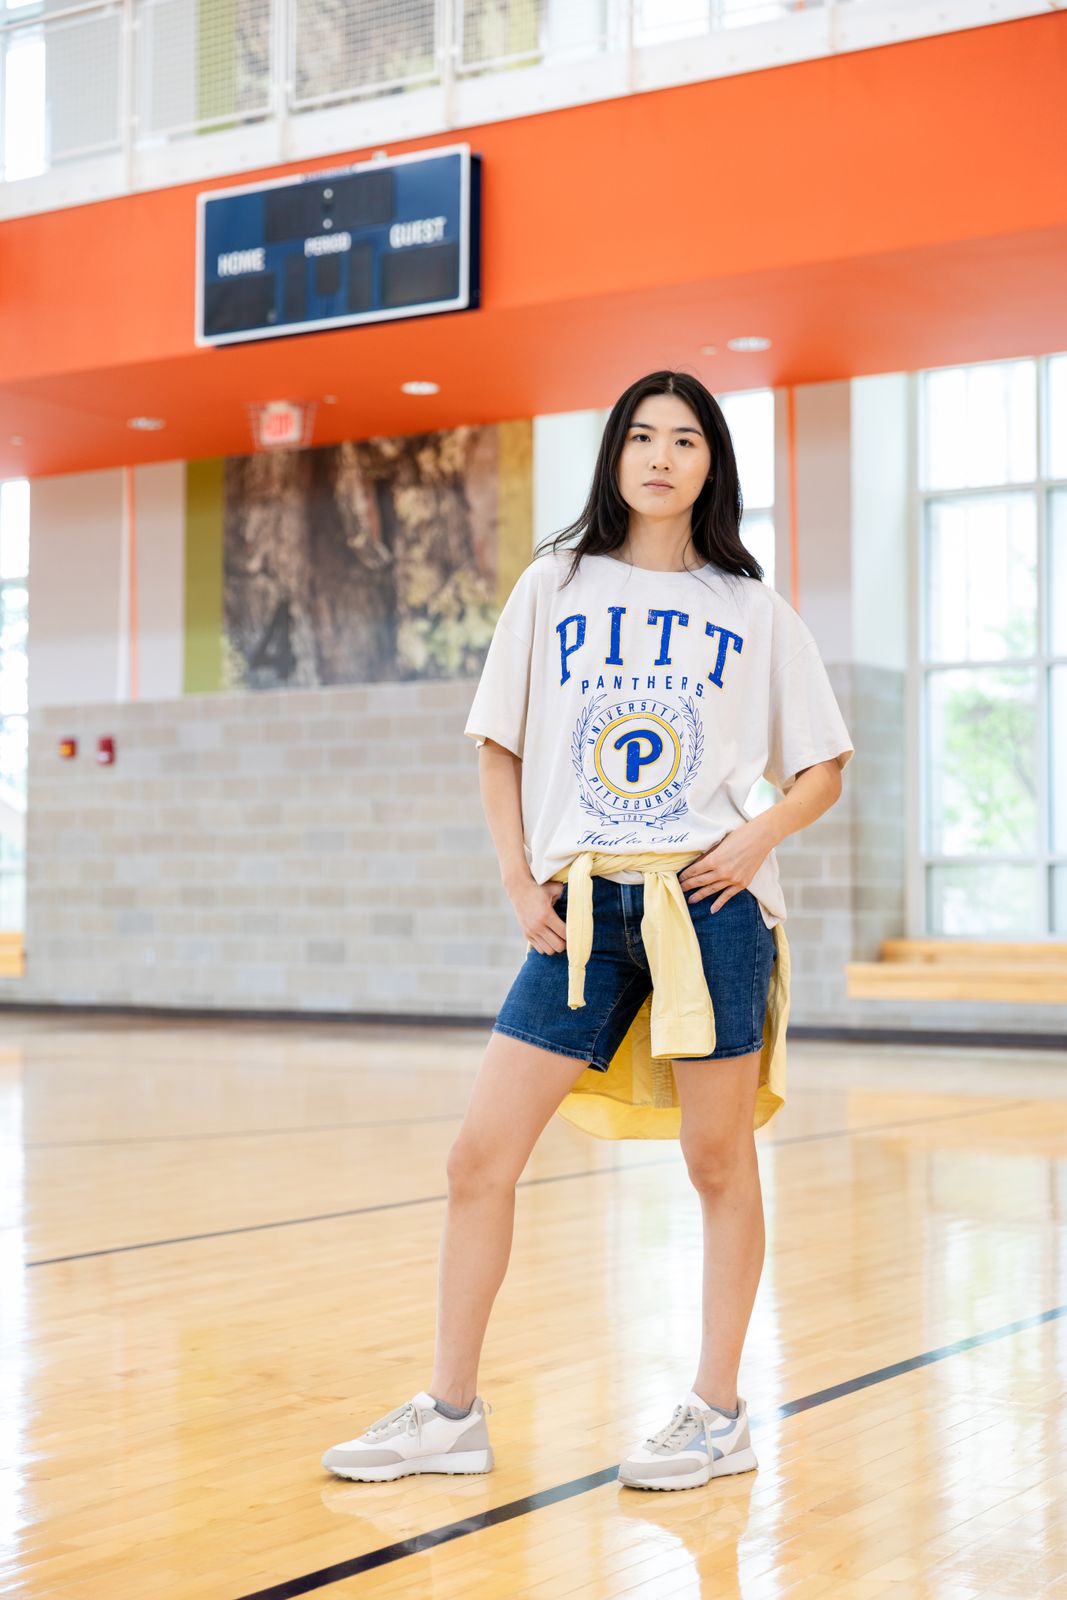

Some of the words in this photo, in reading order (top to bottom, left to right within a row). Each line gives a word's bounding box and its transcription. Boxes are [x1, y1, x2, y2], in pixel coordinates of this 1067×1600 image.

[389, 216, 447, 248] GUEST
[217, 247, 266, 277] HOME
[555, 606, 744, 689] PITT
[581, 675, 703, 698] PANTHERS
[587, 701, 679, 745] UNIVERSITY
[613, 728, 664, 784] P
[588, 776, 682, 810] PITTSBURGH
[576, 830, 634, 846] Hail
